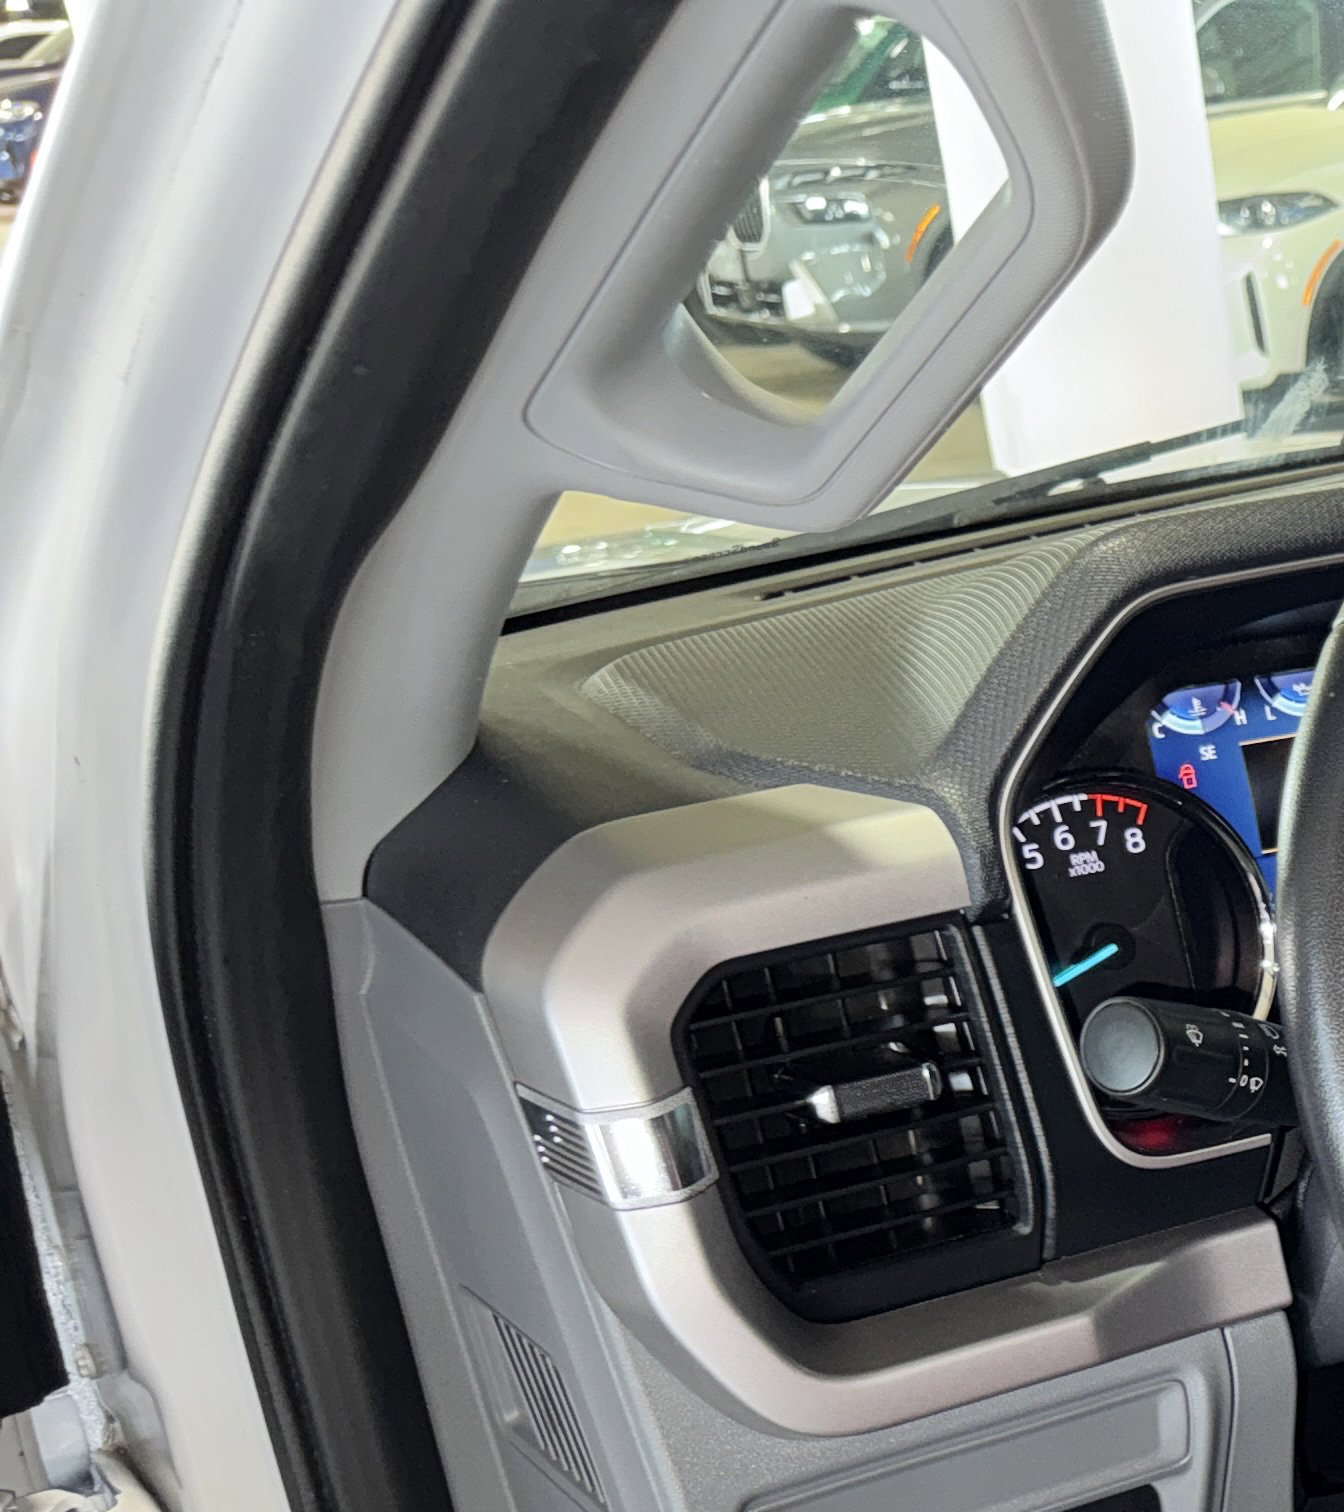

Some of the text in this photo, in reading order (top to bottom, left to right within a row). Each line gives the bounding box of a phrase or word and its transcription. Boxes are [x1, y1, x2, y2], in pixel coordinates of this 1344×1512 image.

[1233, 708, 1248, 726] H
[1264, 704, 1277, 721] L
[1152, 722, 1166, 740] C
[1199, 744, 1218, 760] SE
[1053, 825, 1075, 851] 6
[1089, 820, 1108, 846] 7
[1123, 827, 1146, 854] 8
[1021, 843, 1044, 870] 5
[1068, 850, 1098, 867] RPM
